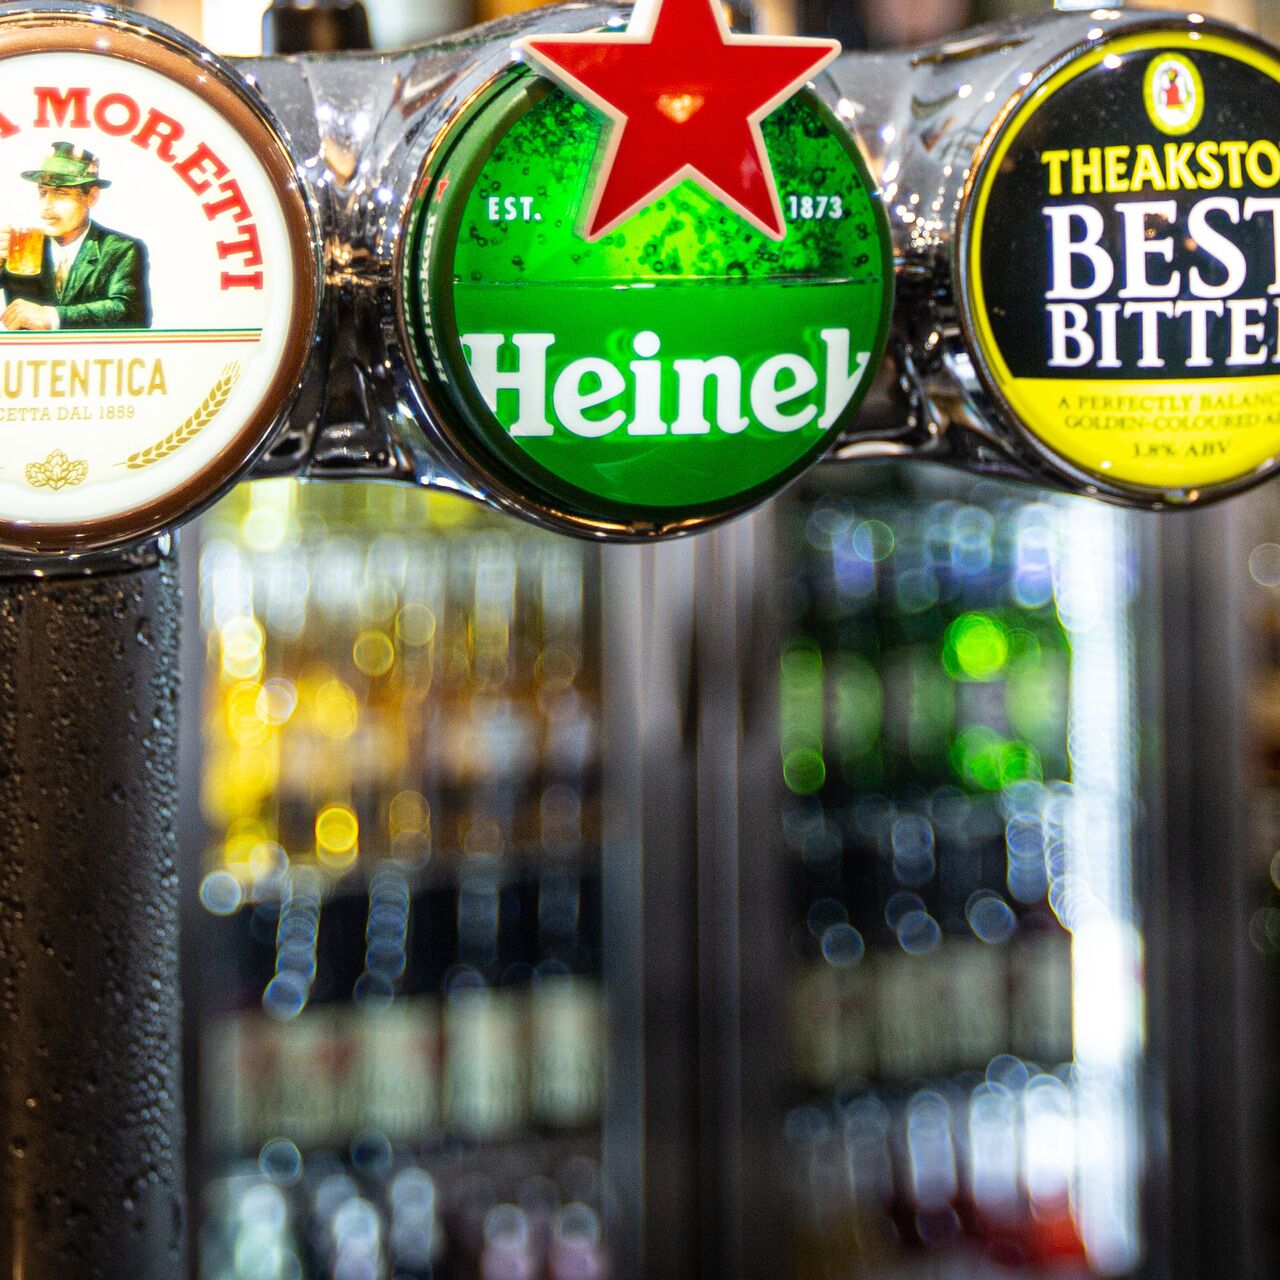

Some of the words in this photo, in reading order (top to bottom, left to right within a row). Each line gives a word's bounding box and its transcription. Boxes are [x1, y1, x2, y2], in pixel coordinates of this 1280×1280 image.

[32, 86, 264, 291] MORETTI
[488, 195, 543, 221] EST.
[789, 194, 843, 220] 1873
[419, 213, 449, 383] Heineken
[57, 406, 92, 421] DAL
[99, 405, 135, 419] 1859
